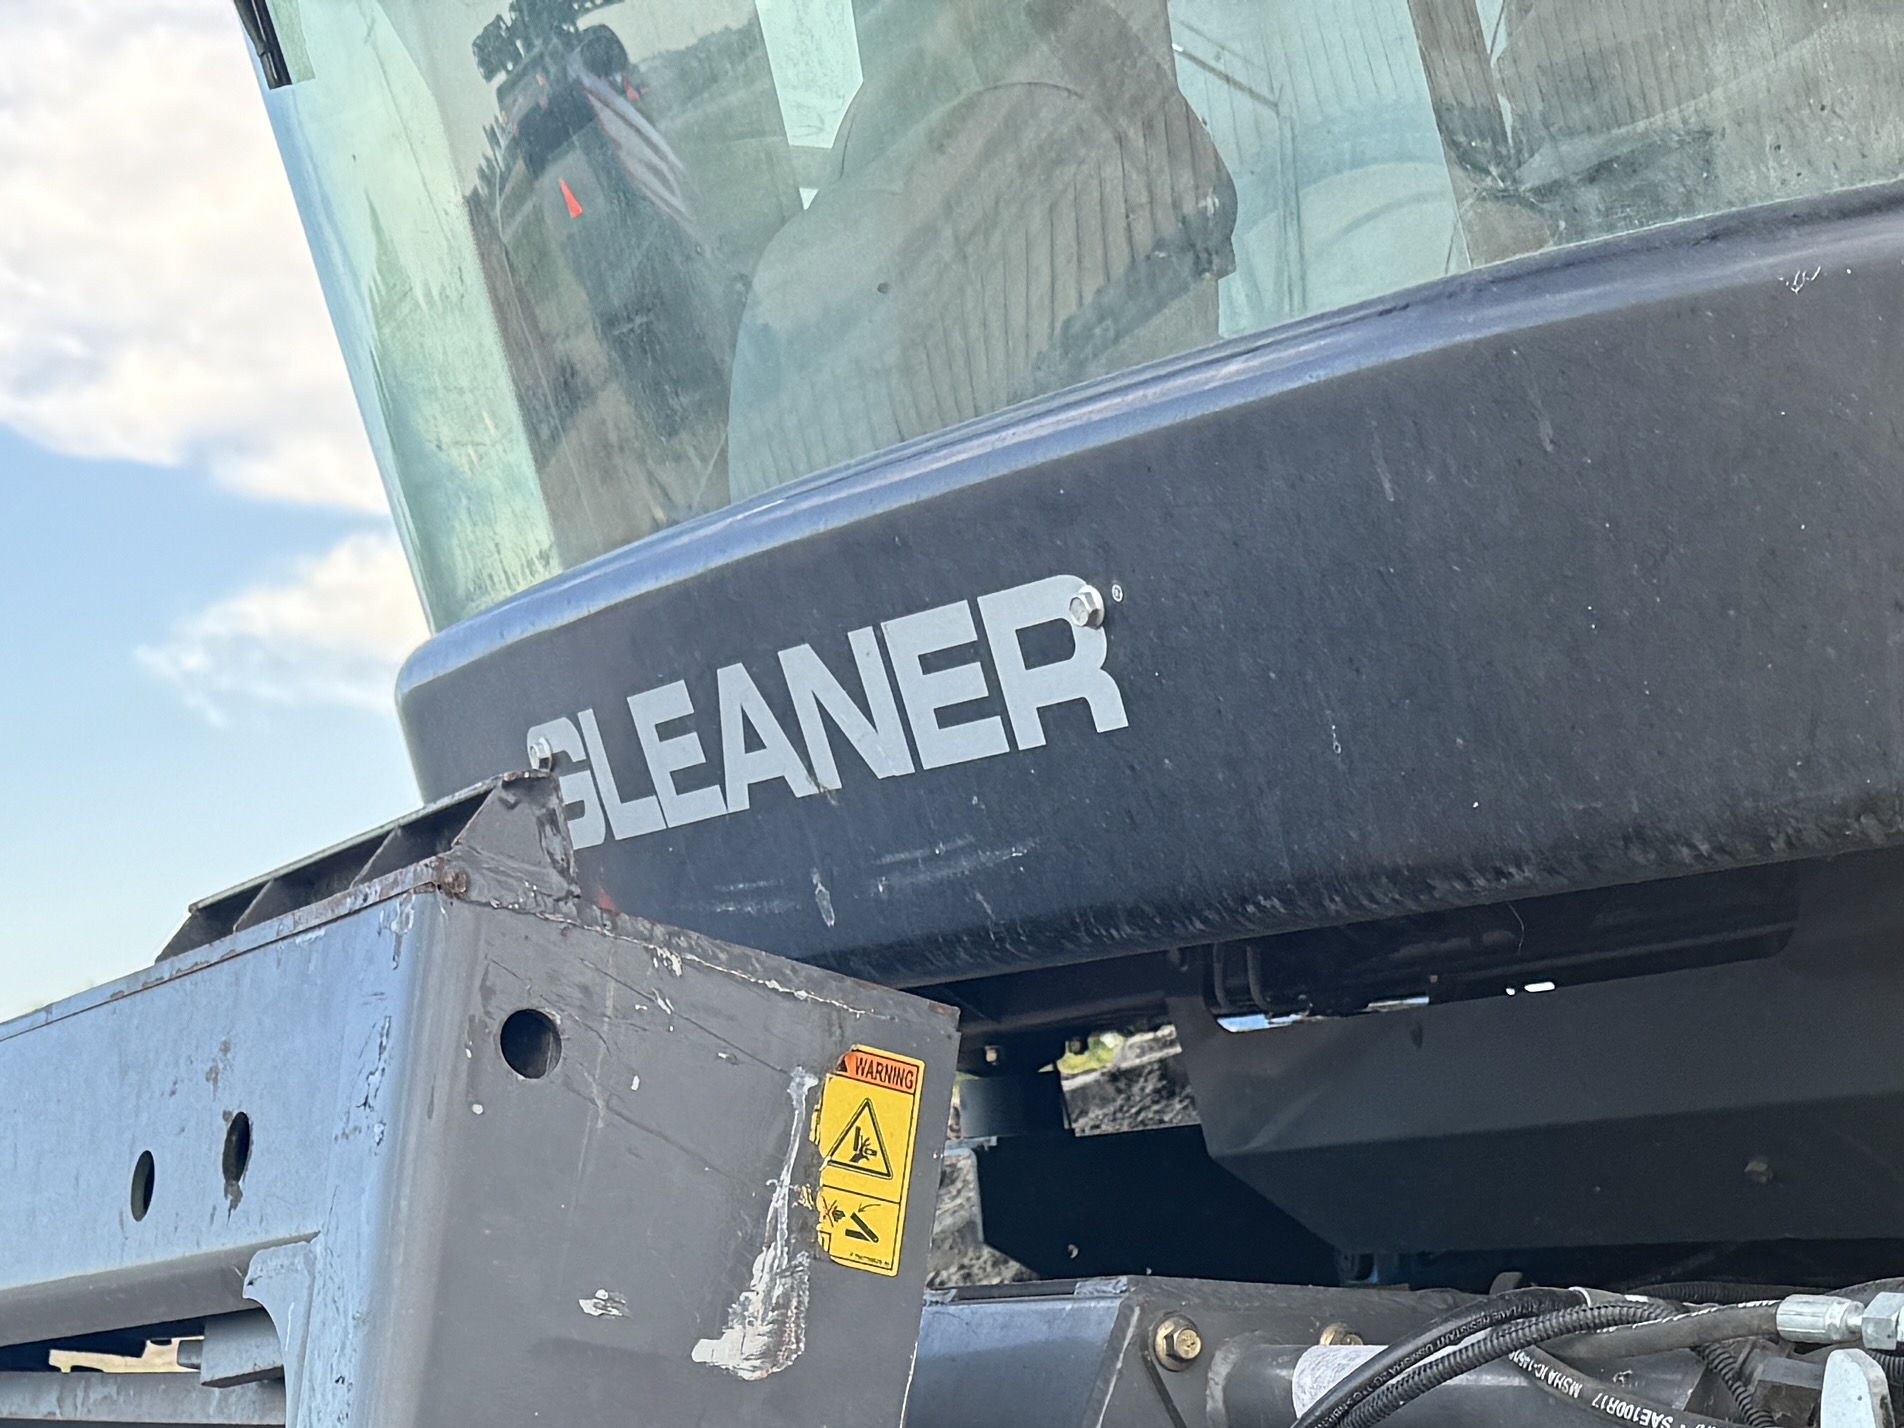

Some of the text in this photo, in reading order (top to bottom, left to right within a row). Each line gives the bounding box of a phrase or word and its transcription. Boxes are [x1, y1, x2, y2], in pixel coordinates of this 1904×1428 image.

[527, 574, 1129, 850] GLEANER
[854, 1057, 914, 1089] WARNING
[1547, 1368, 1583, 1399] MSHA
